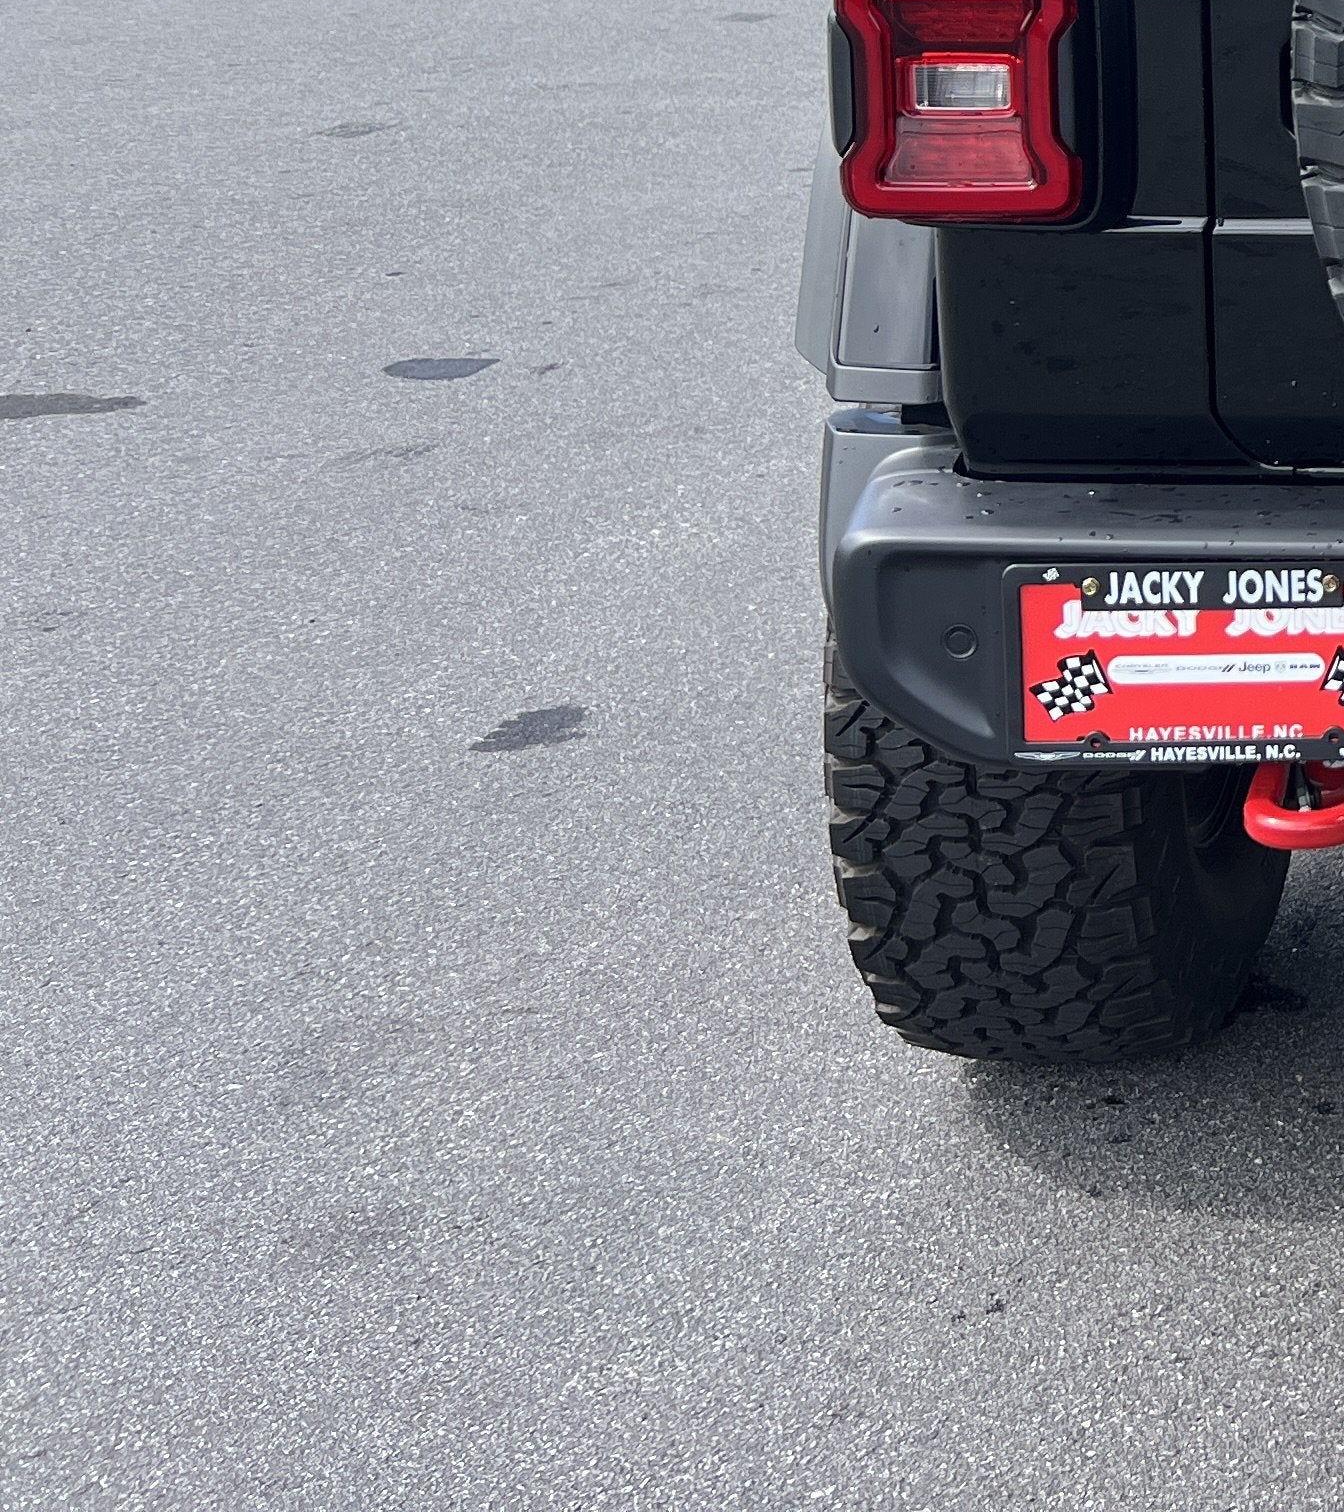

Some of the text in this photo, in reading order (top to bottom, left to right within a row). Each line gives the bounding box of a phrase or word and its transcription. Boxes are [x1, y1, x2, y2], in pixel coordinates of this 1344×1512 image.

[1104, 568, 1325, 605] JACKY JONES
[1053, 599, 1202, 640] JACKY
[1238, 661, 1272, 674] Jeep
[1150, 744, 1262, 763] HAYESVILLE,
[1265, 744, 1302, 761] N.C.
